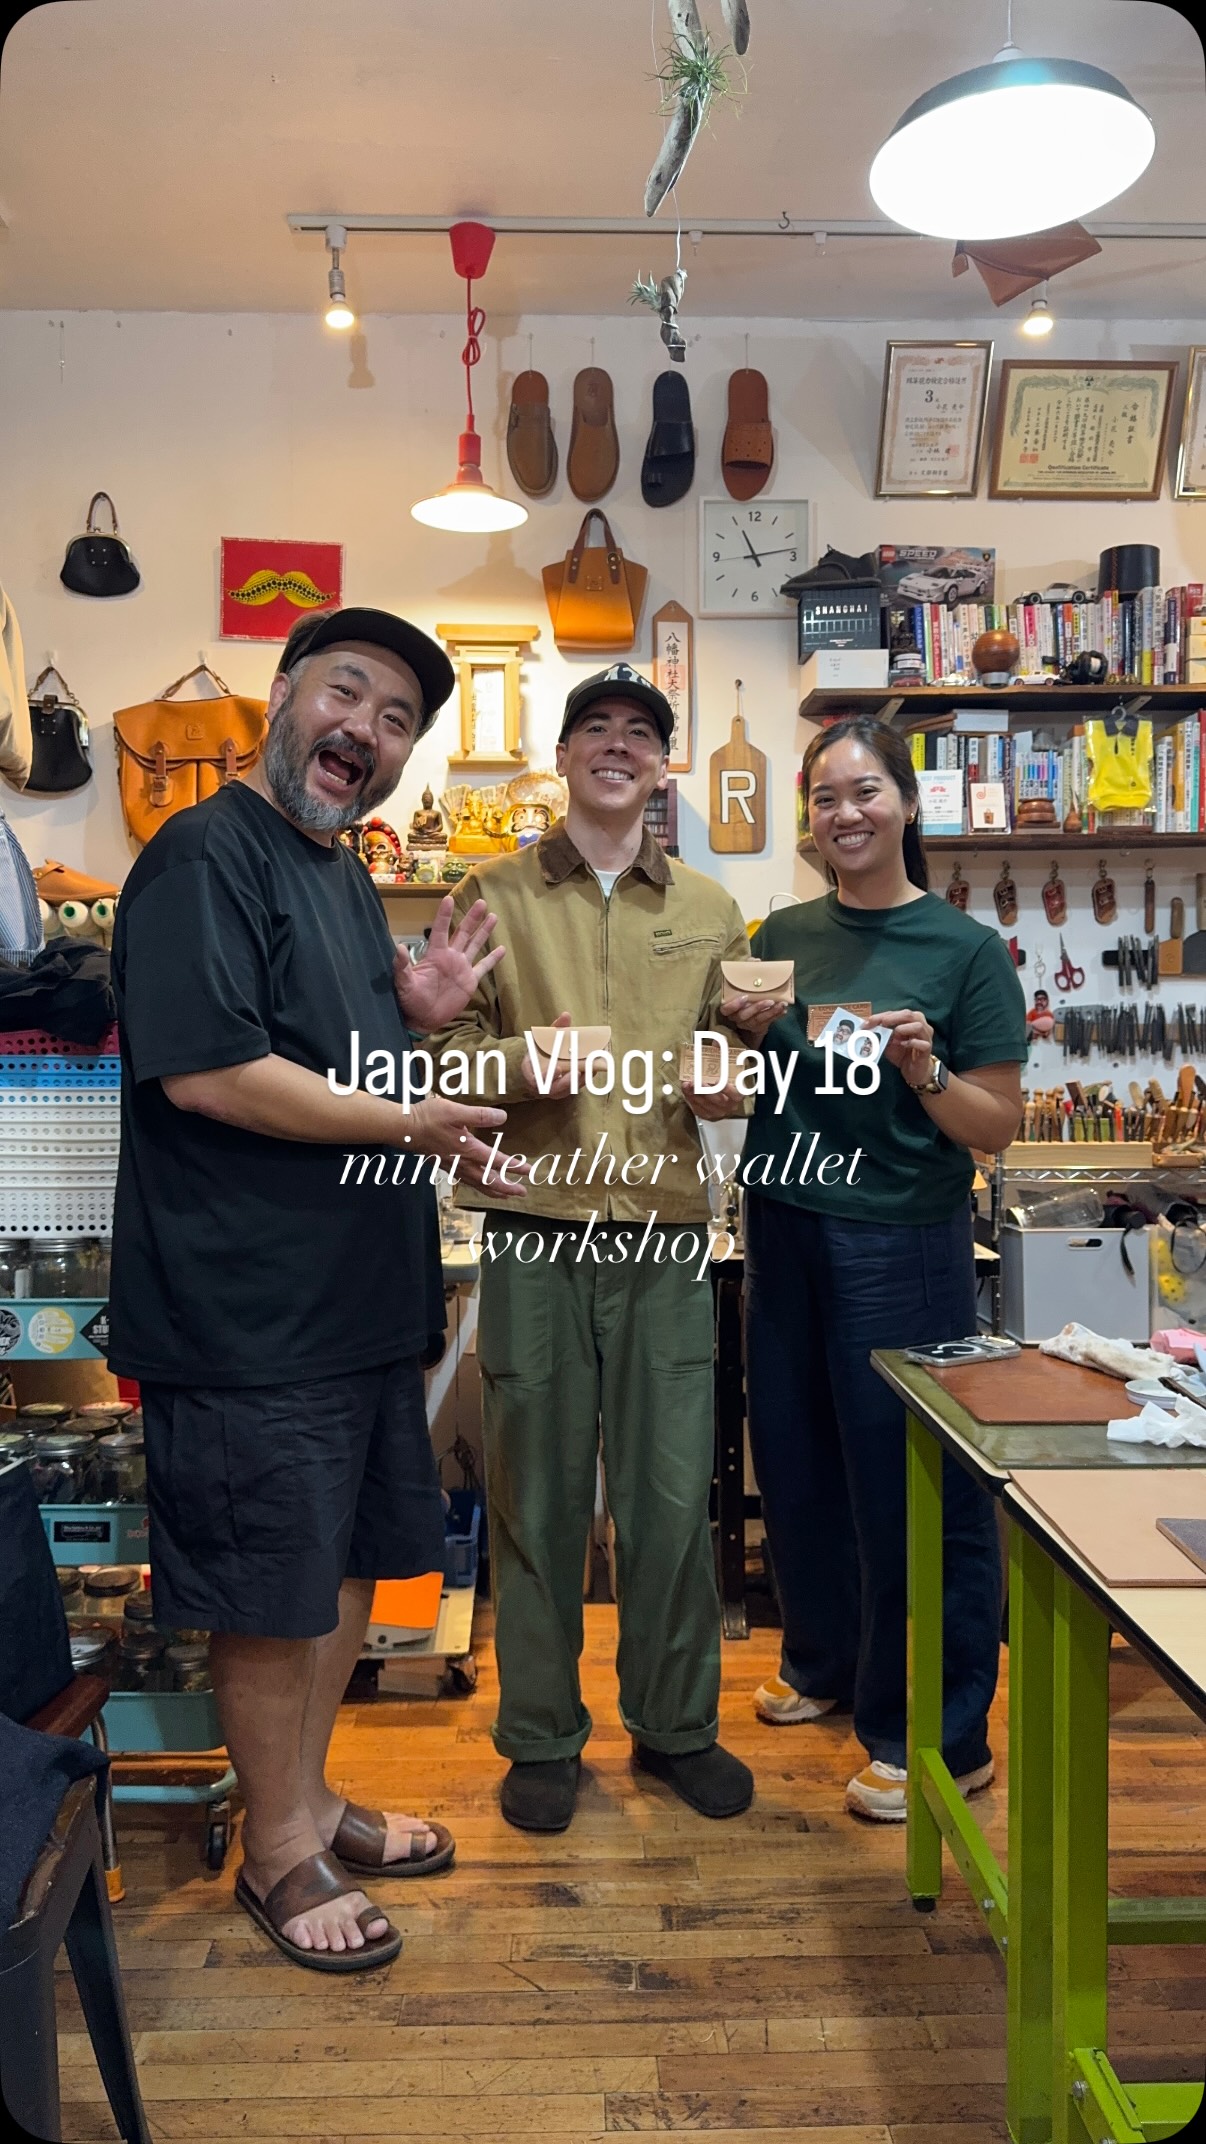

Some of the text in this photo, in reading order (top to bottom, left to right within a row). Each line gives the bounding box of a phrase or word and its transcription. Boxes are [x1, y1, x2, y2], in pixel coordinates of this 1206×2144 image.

[748, 511, 762, 522] 12
[712, 551, 721, 563] 9
[790, 551, 798, 563] 3
[900, 549, 937, 558] SPEED
[751, 591, 760, 602] 6
[815, 603, 868, 616] SHANGHAI
[719, 768, 758, 825] R
